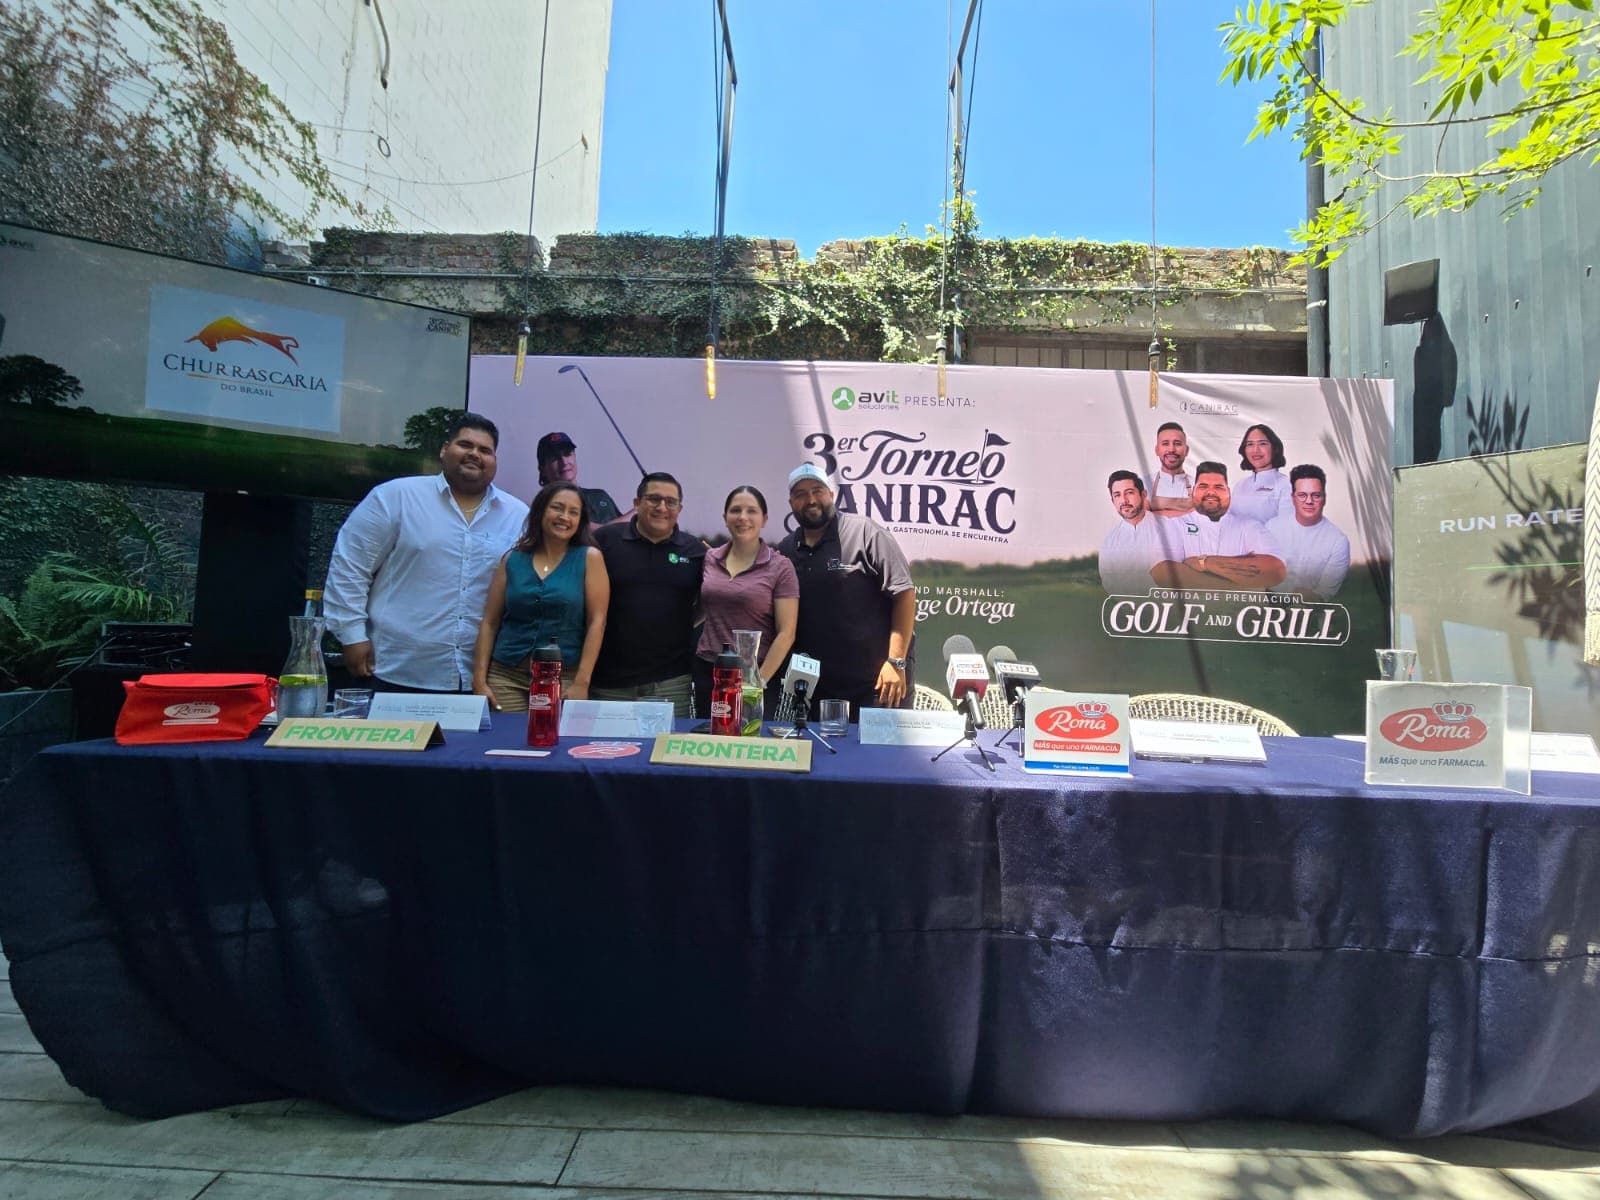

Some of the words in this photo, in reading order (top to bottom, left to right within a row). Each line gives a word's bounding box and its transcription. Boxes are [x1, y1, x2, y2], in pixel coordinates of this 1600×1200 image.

[163, 353, 328, 393] CHURRASCARIA
[221, 383, 237, 391] DO
[240, 386, 274, 397] BRASIL
[858, 390, 899, 404] avit
[904, 396, 976, 408] PRESENTA:
[1190, 402, 1238, 412] CANIRAC
[841, 430, 1006, 482] Torneo
[784, 484, 1017, 534] ANIRAC
[1439, 514, 1497, 534] RUN
[1505, 507, 1584, 529] RATE
[893, 526, 949, 537] GASTRONOMÍA
[963, 532, 1009, 544] ENCUENTRA
[936, 587, 1005, 597] MARSHALL:
[1153, 590, 1200, 600] COMIDA
[1205, 592, 1221, 601] DE
[1225, 593, 1300, 604] PREMIACIÓN
[945, 595, 1016, 625] Ortega
[1109, 600, 1205, 635] GOLF
[1204, 614, 1232, 627] AND
[1236, 605, 1342, 641] GRILL
[174, 704, 212, 716] Roma
[1047, 710, 1108, 733] Roma
[1395, 713, 1472, 744] Roma
[282, 725, 416, 744] FRONTERA
[665, 738, 798, 763] FRONTERA
[1034, 741, 1050, 750] MÁS
[1051, 744, 1065, 752] que
[1379, 754, 1400, 765] MÁS
[1401, 758, 1418, 767] que
